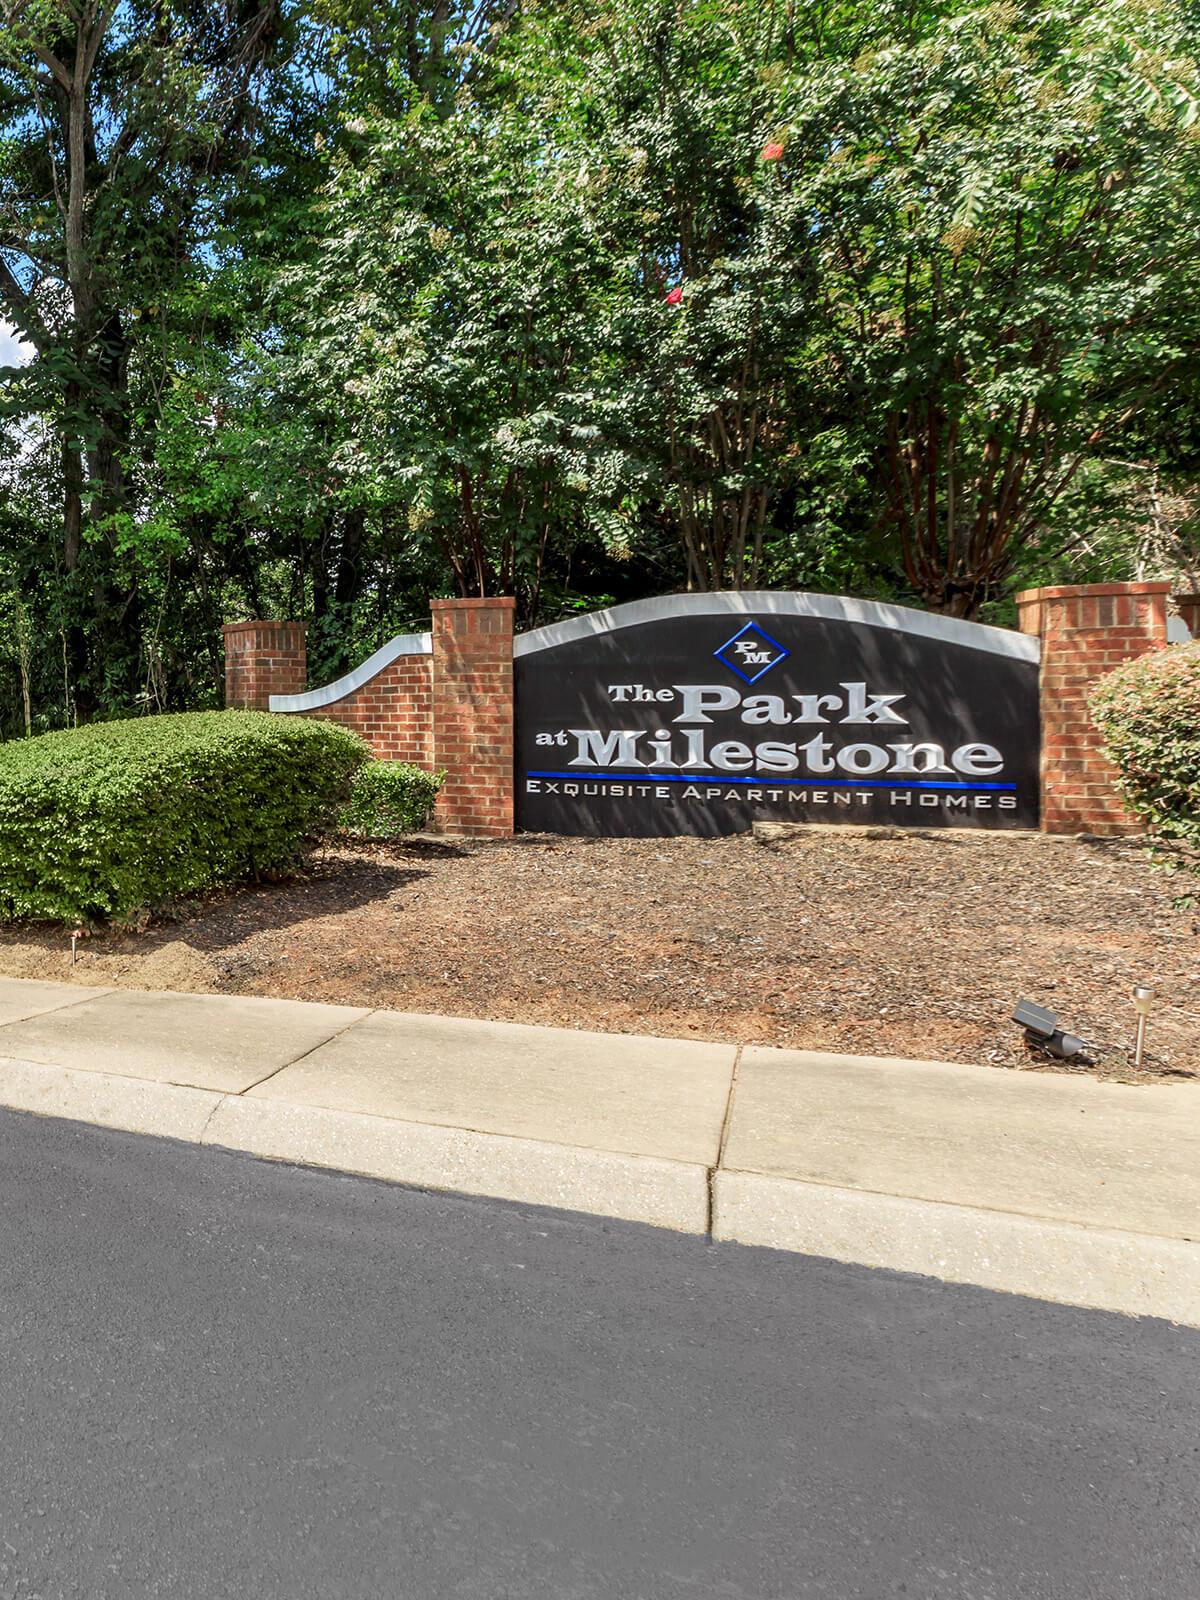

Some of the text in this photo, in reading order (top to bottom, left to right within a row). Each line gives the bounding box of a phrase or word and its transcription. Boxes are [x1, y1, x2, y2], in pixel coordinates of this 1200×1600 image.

[608, 682, 909, 725] The Park
[535, 729, 1004, 774] at Milestone
[526, 780, 1017, 809] EXQUISITE APARTMENT HOMES
